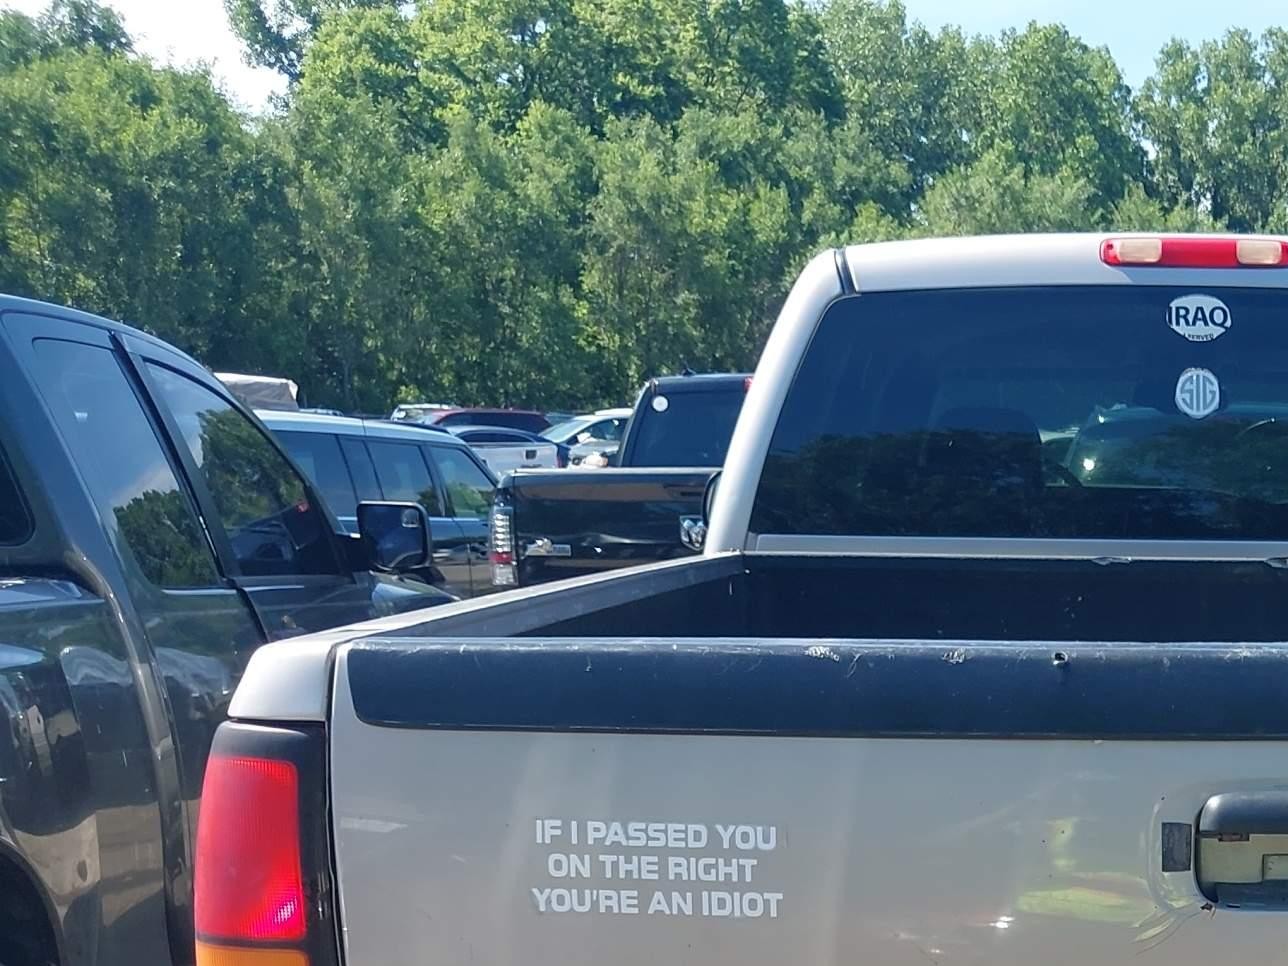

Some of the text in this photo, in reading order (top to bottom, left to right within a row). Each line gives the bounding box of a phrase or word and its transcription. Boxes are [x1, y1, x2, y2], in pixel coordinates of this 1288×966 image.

[1167, 305, 1229, 330] IRAQ
[1179, 373, 1218, 413] SIG
[535, 819, 777, 851] IF I PASSED YOU
[548, 853, 758, 883] ON THE RIGHT
[531, 887, 784, 918] YOU'RE AN IDIOT
